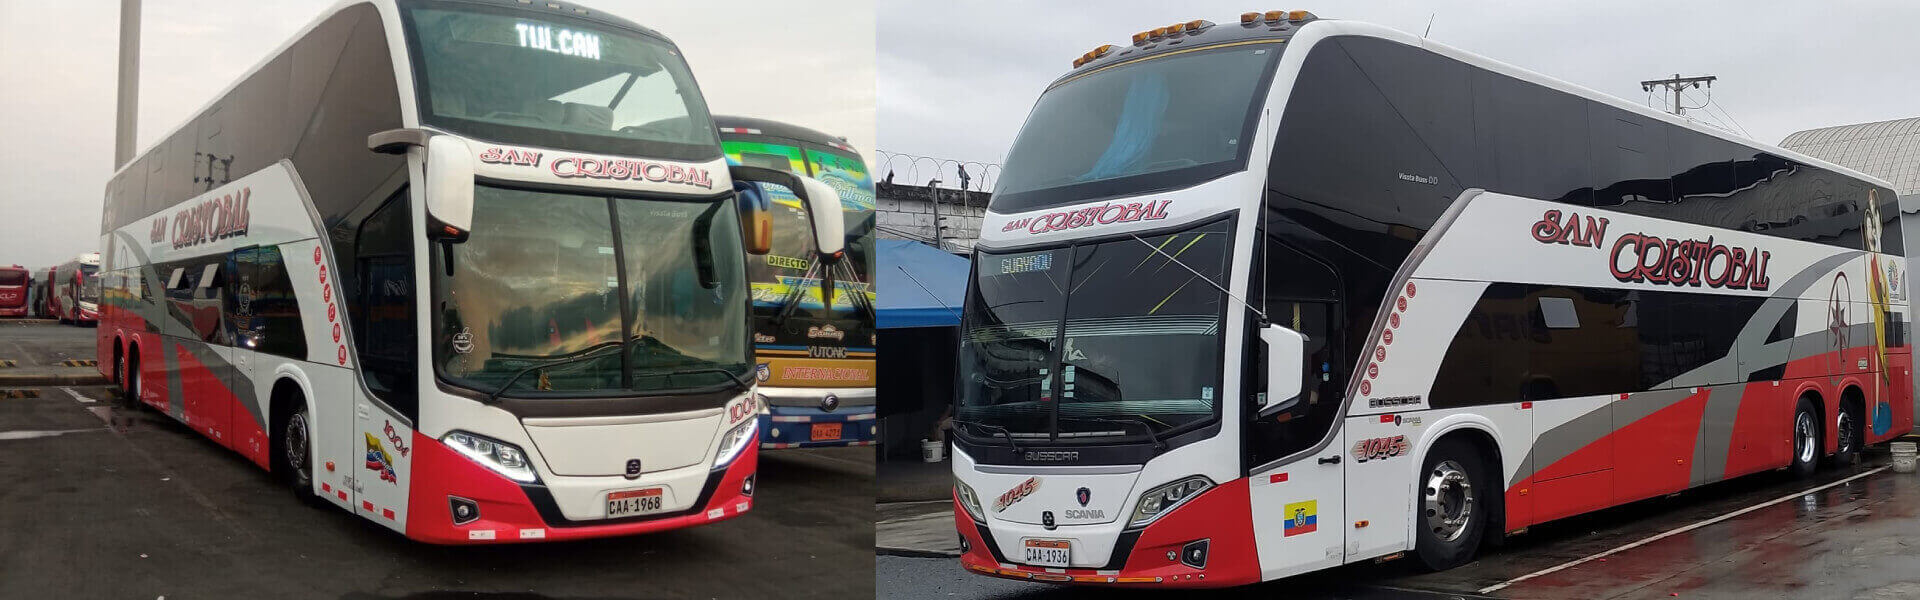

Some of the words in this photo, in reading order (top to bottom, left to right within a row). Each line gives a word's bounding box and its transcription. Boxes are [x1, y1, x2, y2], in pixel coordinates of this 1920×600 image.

[515, 23, 600, 60] TULCAN
[480, 147, 543, 168] SAN
[550, 157, 713, 190] CRISTOBAL
[151, 215, 168, 244] SAN
[172, 186, 251, 250] CRISTOBAL
[1002, 217, 1032, 233] SAN
[1028, 200, 1173, 235] CRISTOBAL
[768, 256, 808, 269] DIRECTO
[1531, 209, 1609, 249] SAN
[1609, 231, 1771, 292] CRISTOBAL
[807, 345, 849, 358] YUTONG
[782, 366, 870, 381] INTERNACIONAL
[383, 419, 410, 458] 1004
[1358, 434, 1404, 463] 1045
[1025, 451, 1079, 461] BUSSCAR
[609, 496, 661, 515] CAA-1968
[999, 477, 1035, 513] 1045
[1065, 509, 1106, 520] SCANIA
[1026, 548, 1067, 563] CAA-1936
